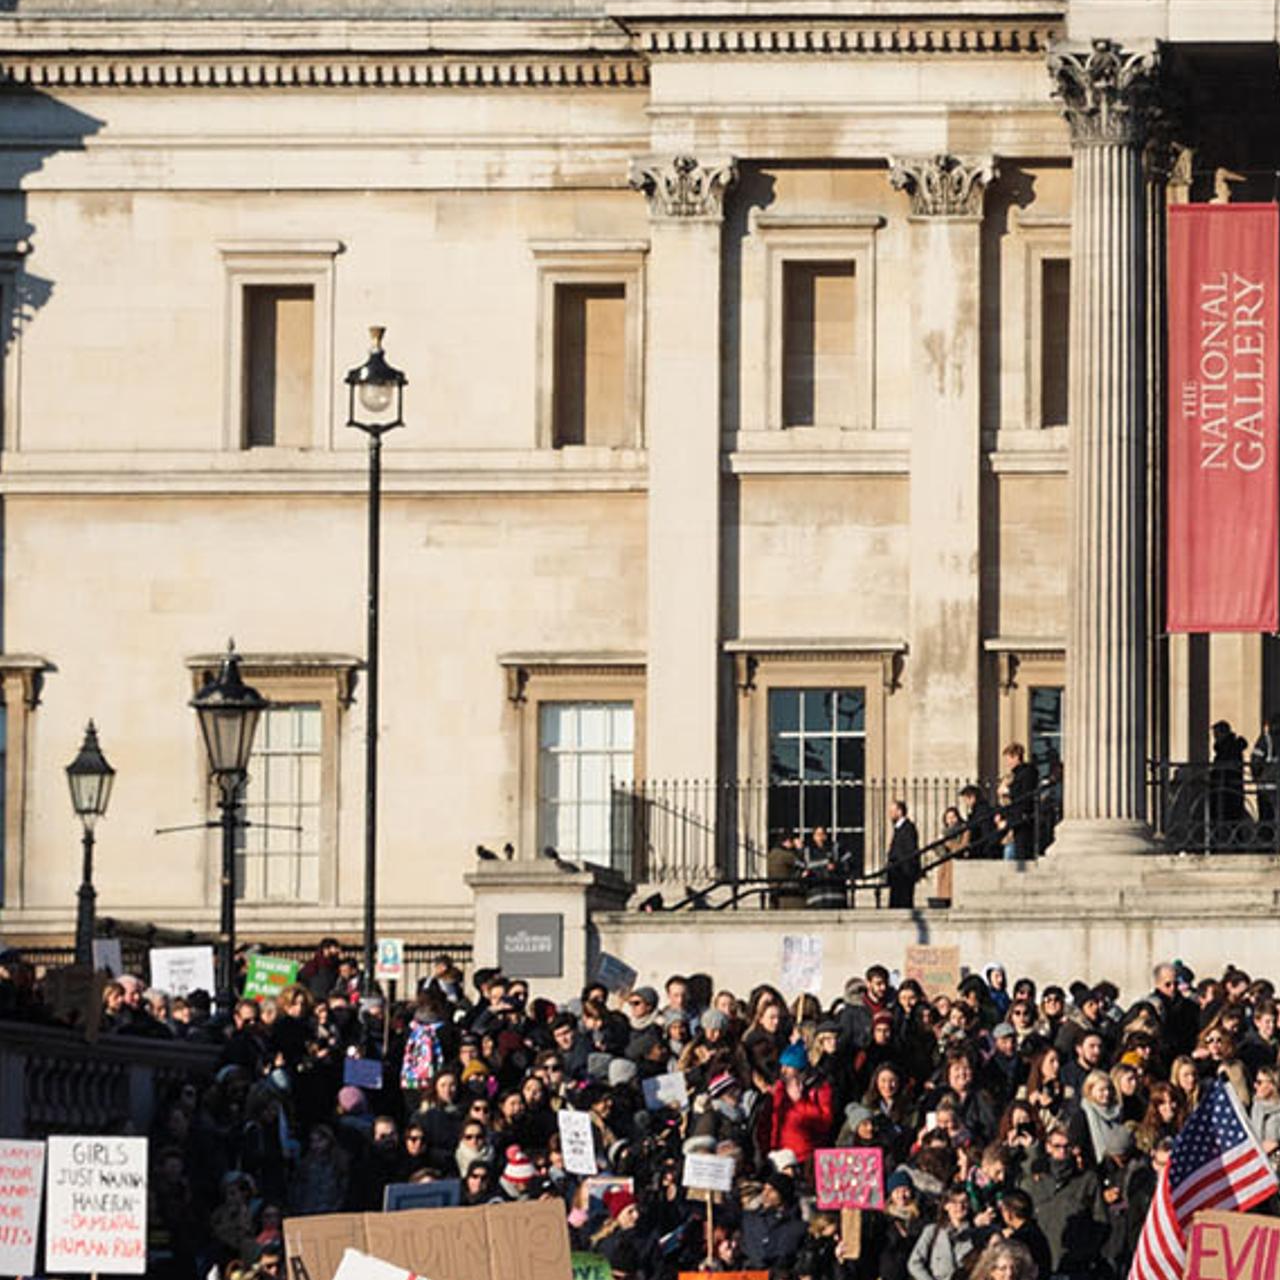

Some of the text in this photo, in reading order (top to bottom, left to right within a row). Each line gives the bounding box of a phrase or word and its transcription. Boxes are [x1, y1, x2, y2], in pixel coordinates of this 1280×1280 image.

[1201, 271, 1229, 470] NATIONAL
[1233, 273, 1265, 472] GALLERY
[1183, 380, 1198, 418] THE
[72, 1142, 129, 1166] GIRLS
[56, 1169, 93, 1187] JUST
[52, 1236, 108, 1258] HUMAN
